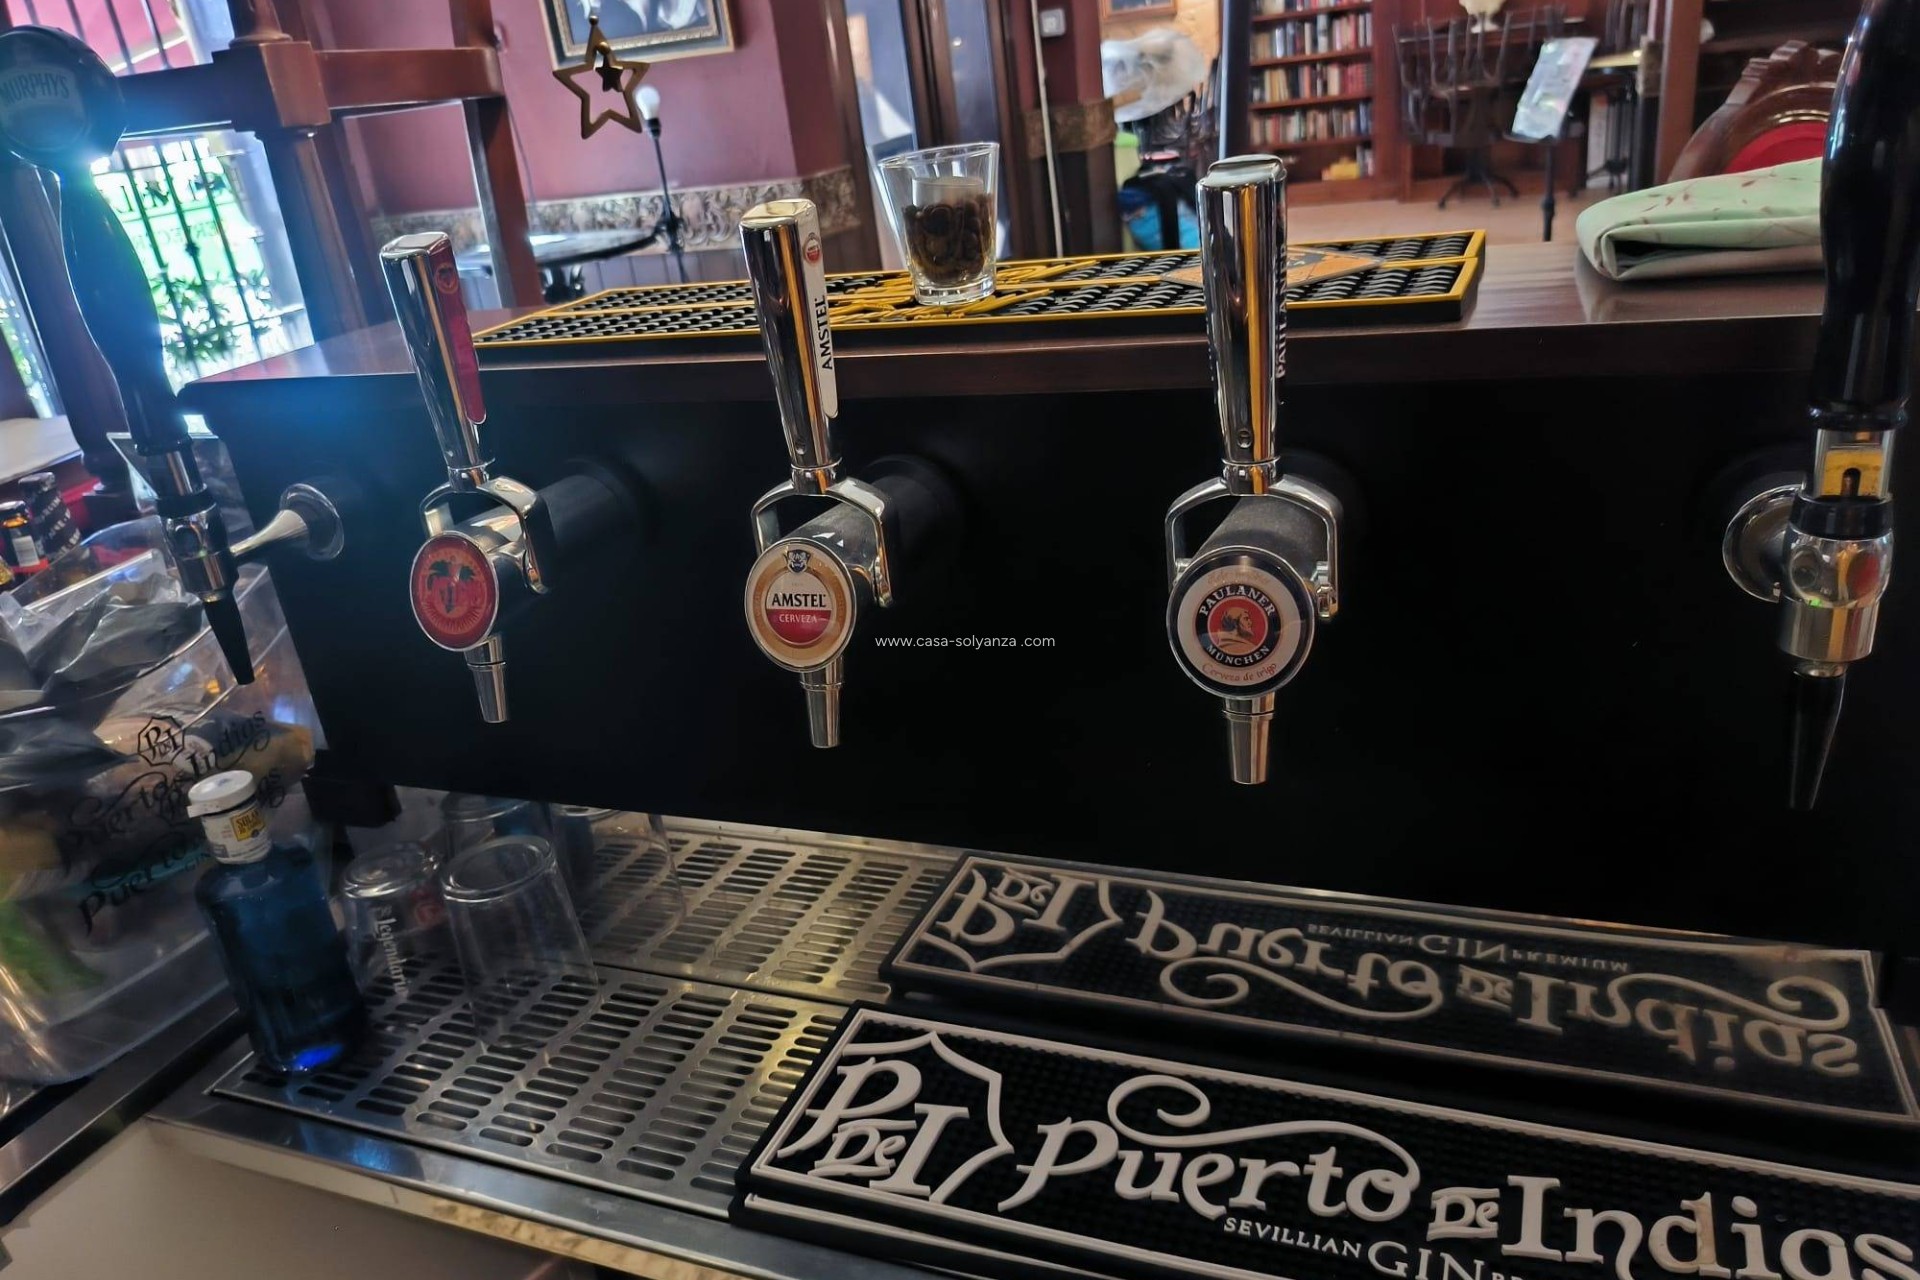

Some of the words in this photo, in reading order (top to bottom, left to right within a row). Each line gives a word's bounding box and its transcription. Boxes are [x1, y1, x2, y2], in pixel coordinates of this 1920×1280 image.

[814, 295, 834, 370] AMSTEL
[771, 593, 826, 608] AMSTEL
[779, 613, 818, 624] CERVEZA
[1199, 585, 1276, 616] PAULANER
[997, 1075, 1421, 1222] Puerto
[1501, 1174, 1920, 1280] Indias
[1224, 1217, 1362, 1259] SEVILLIAN
[1367, 1240, 1485, 1280] GIN
